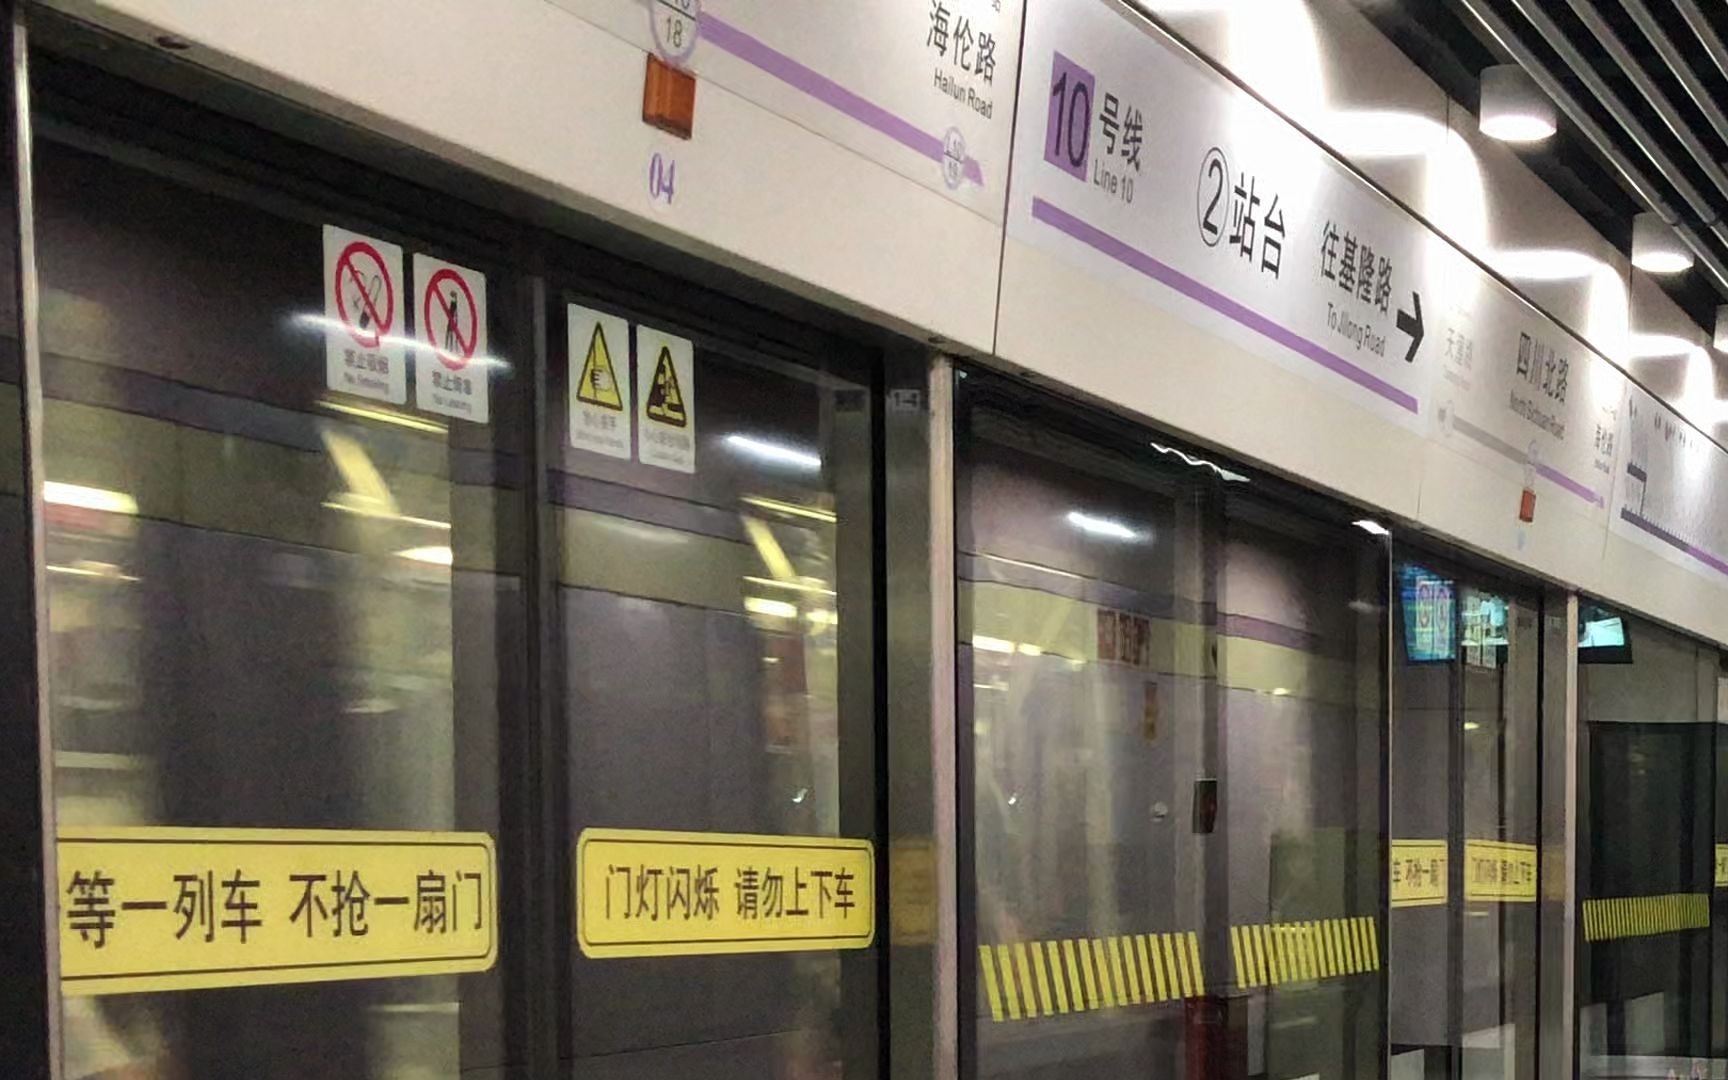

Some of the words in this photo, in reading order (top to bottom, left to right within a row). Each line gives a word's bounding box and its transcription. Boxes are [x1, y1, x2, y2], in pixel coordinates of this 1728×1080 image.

[927, 0, 996, 87] 海伦路
[933, 67, 966, 104] Hailun
[967, 87, 993, 120] Road
[1052, 71, 1090, 168] 10
[1100, 92, 1143, 172] 号线
[1093, 158, 1117, 194] Line
[1121, 174, 1134, 204] 10
[1320, 218, 1392, 316] 往基隆路
[66, 869, 263, 950] 等一列车
[289, 869, 482, 939] 不抢一扇门
[606, 863, 720, 922] 门灯闪烁
[734, 865, 856, 921] 请勿上下车
